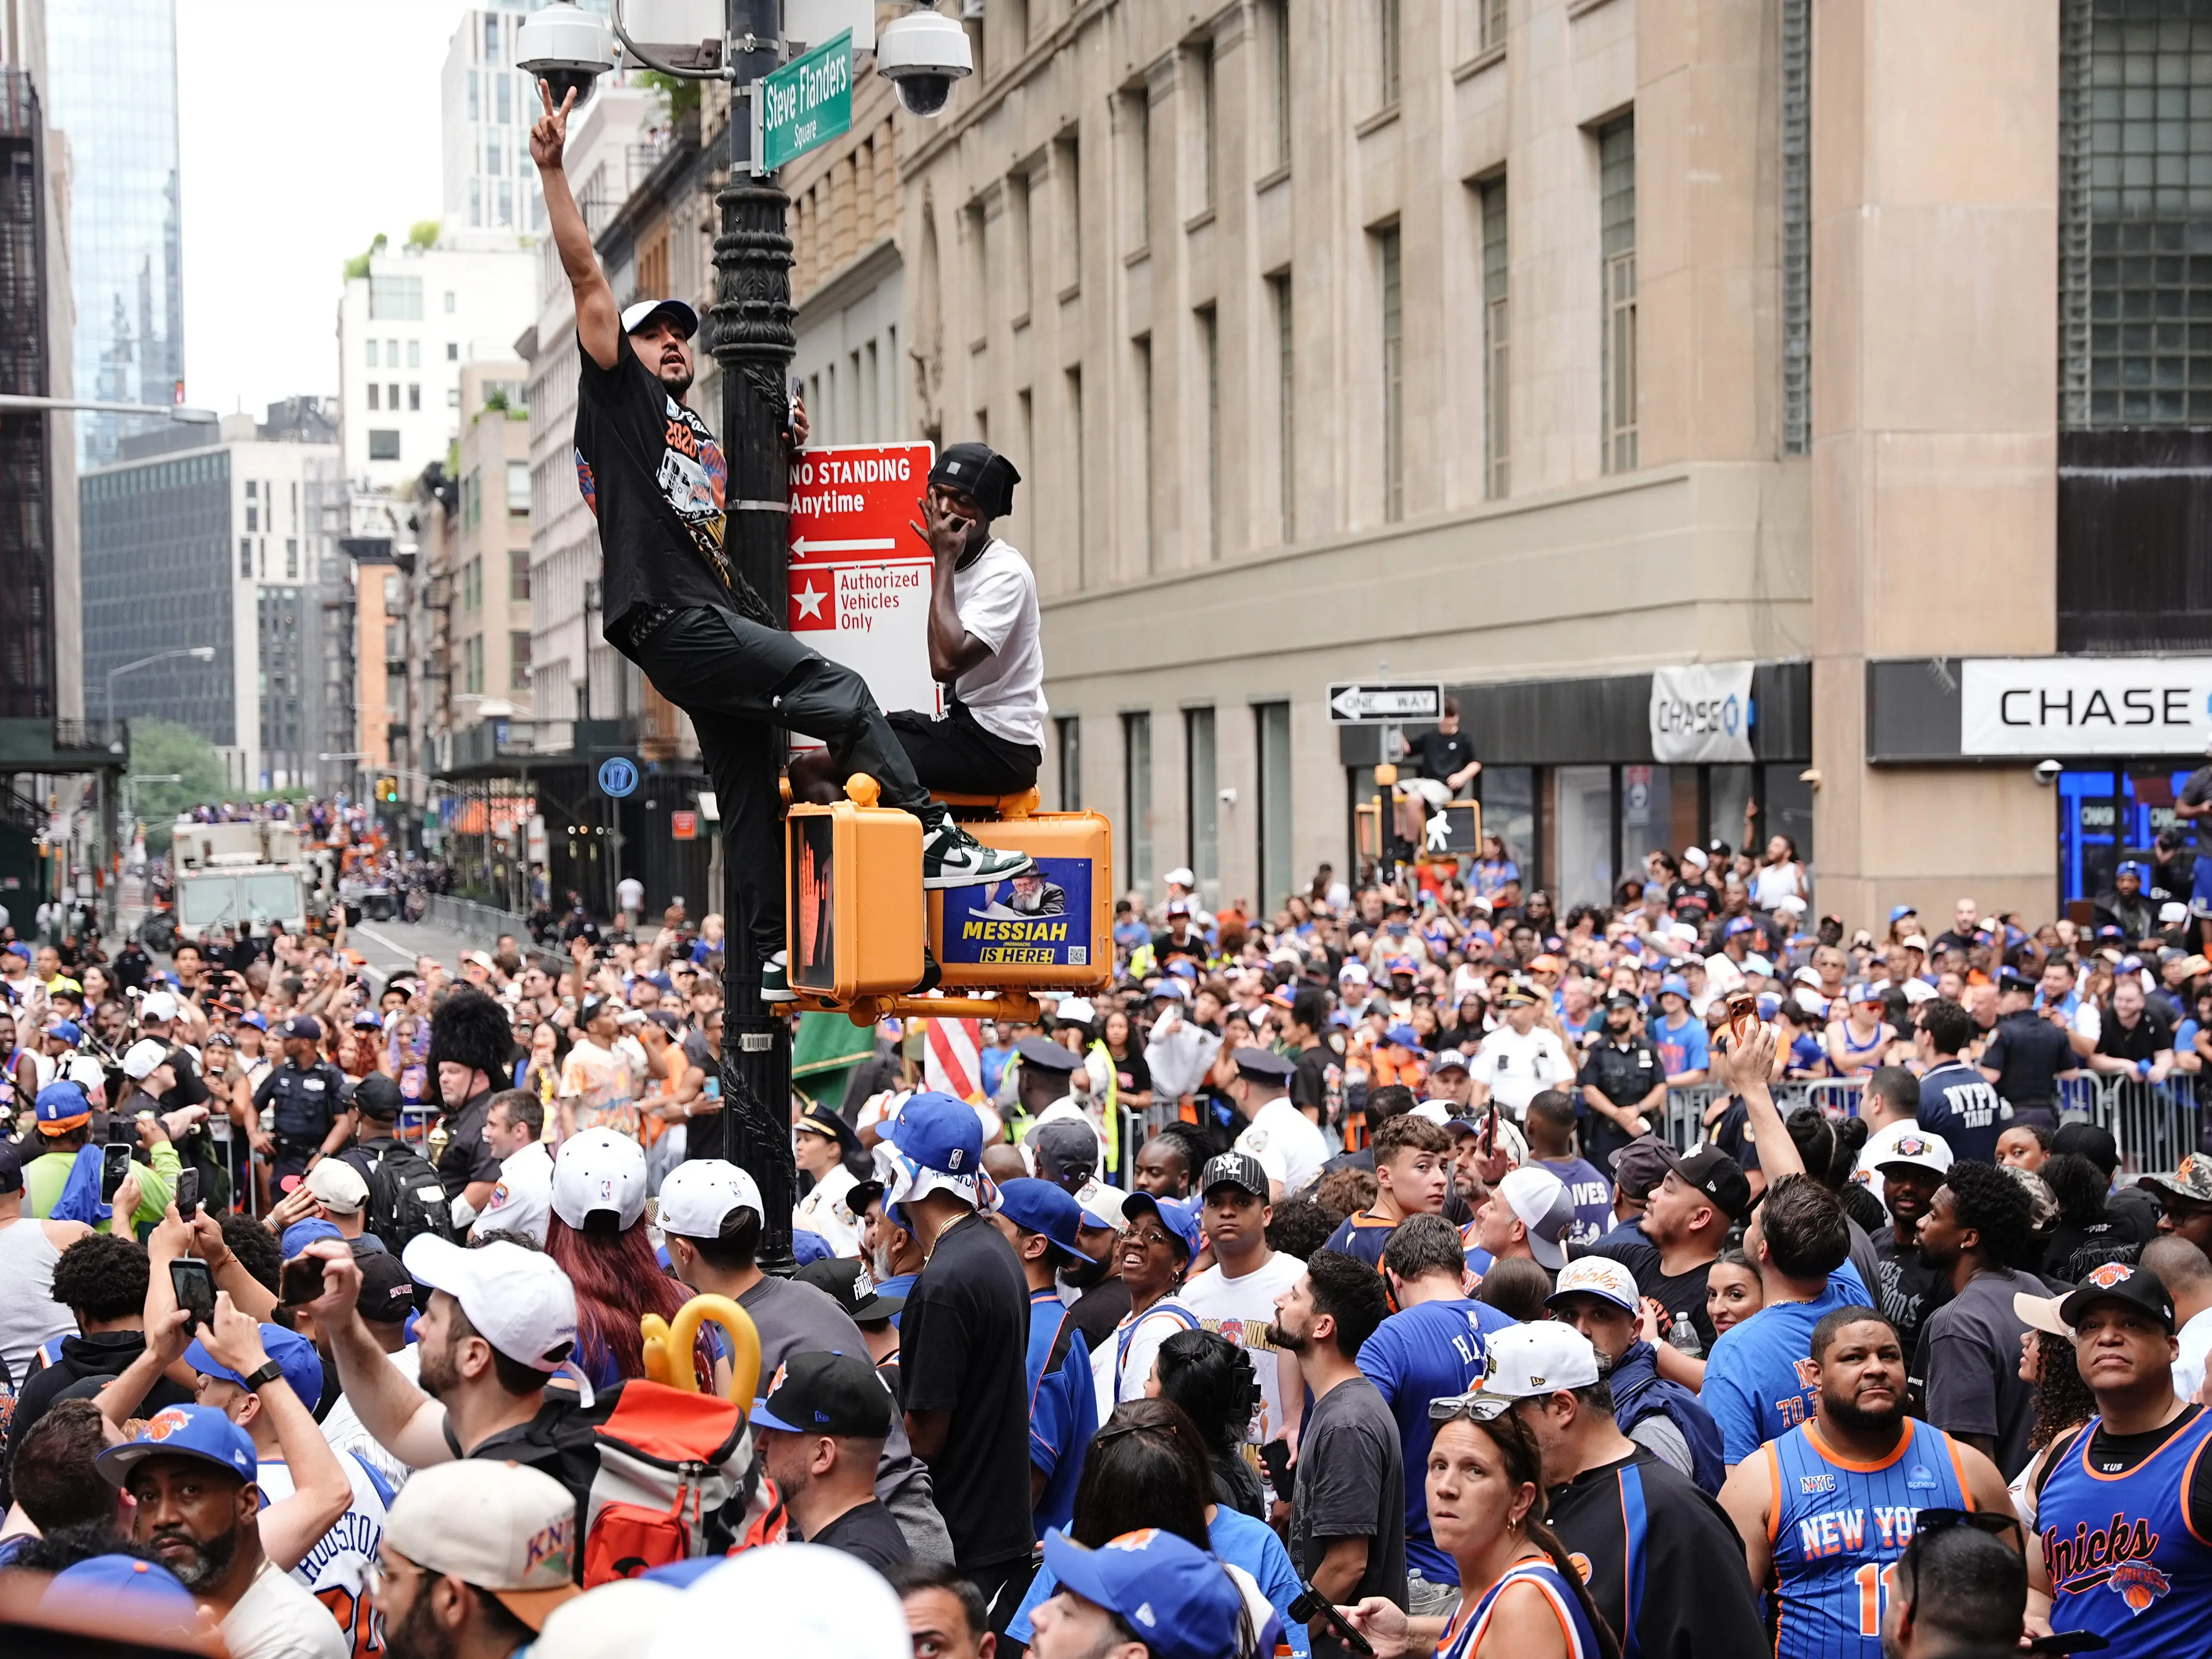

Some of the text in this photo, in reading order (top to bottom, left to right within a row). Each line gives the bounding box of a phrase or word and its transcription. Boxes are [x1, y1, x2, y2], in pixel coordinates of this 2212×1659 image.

[767, 51, 846, 131] Steve Flanders
[794, 119, 817, 151] Square
[789, 458, 910, 485] NO STANDING
[790, 490, 864, 519] Anytime
[841, 571, 919, 591] Authorized
[841, 592, 900, 610] Vehicles
[841, 613, 872, 633] Only
[1344, 692, 1431, 711] ONE WAY
[2001, 689, 2191, 725] CHASE
[1659, 701, 1721, 733] CHASE
[962, 921, 1068, 941] MESSIAH
[982, 948, 1052, 963] IS HERE!
[1963, 1108, 1993, 1129] TARU
[1571, 1181, 1608, 1207] IVES
[1242, 1320, 1278, 1354] WOR
[1793, 1356, 1813, 1390] N
[1776, 1390, 1818, 1428] TO T
[1800, 1474, 1836, 1494] NYC
[1907, 1480, 1937, 1490] sphere
[1800, 1506, 1926, 1561] NEW YO
[2042, 1512, 2160, 1603] Knicks
[2111, 1565, 2169, 1590] KNICKS
